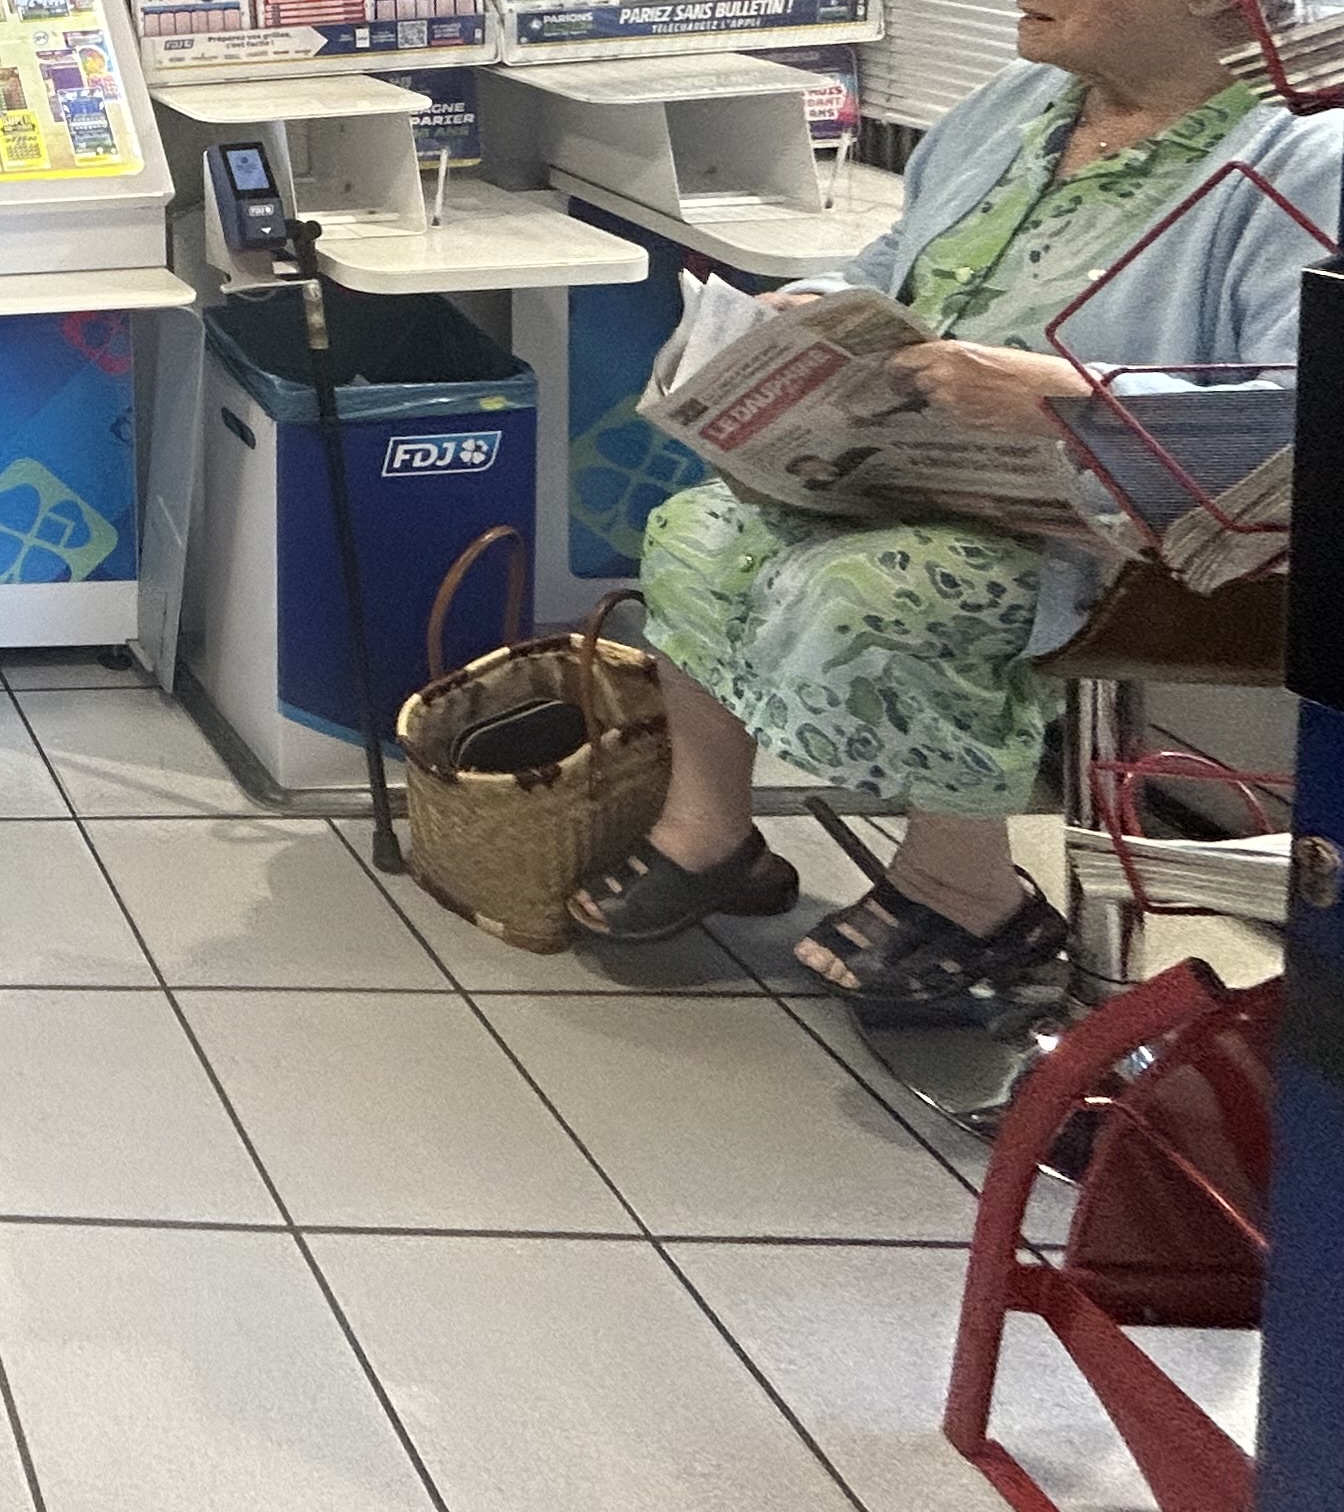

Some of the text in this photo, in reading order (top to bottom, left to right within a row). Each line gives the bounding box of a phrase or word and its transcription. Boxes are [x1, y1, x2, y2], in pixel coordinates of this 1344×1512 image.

[543, 11, 594, 25] PARIONS
[619, 6, 671, 25] PARIEZ
[674, 2, 712, 22] SANS
[393, 441, 456, 468] FDJ
